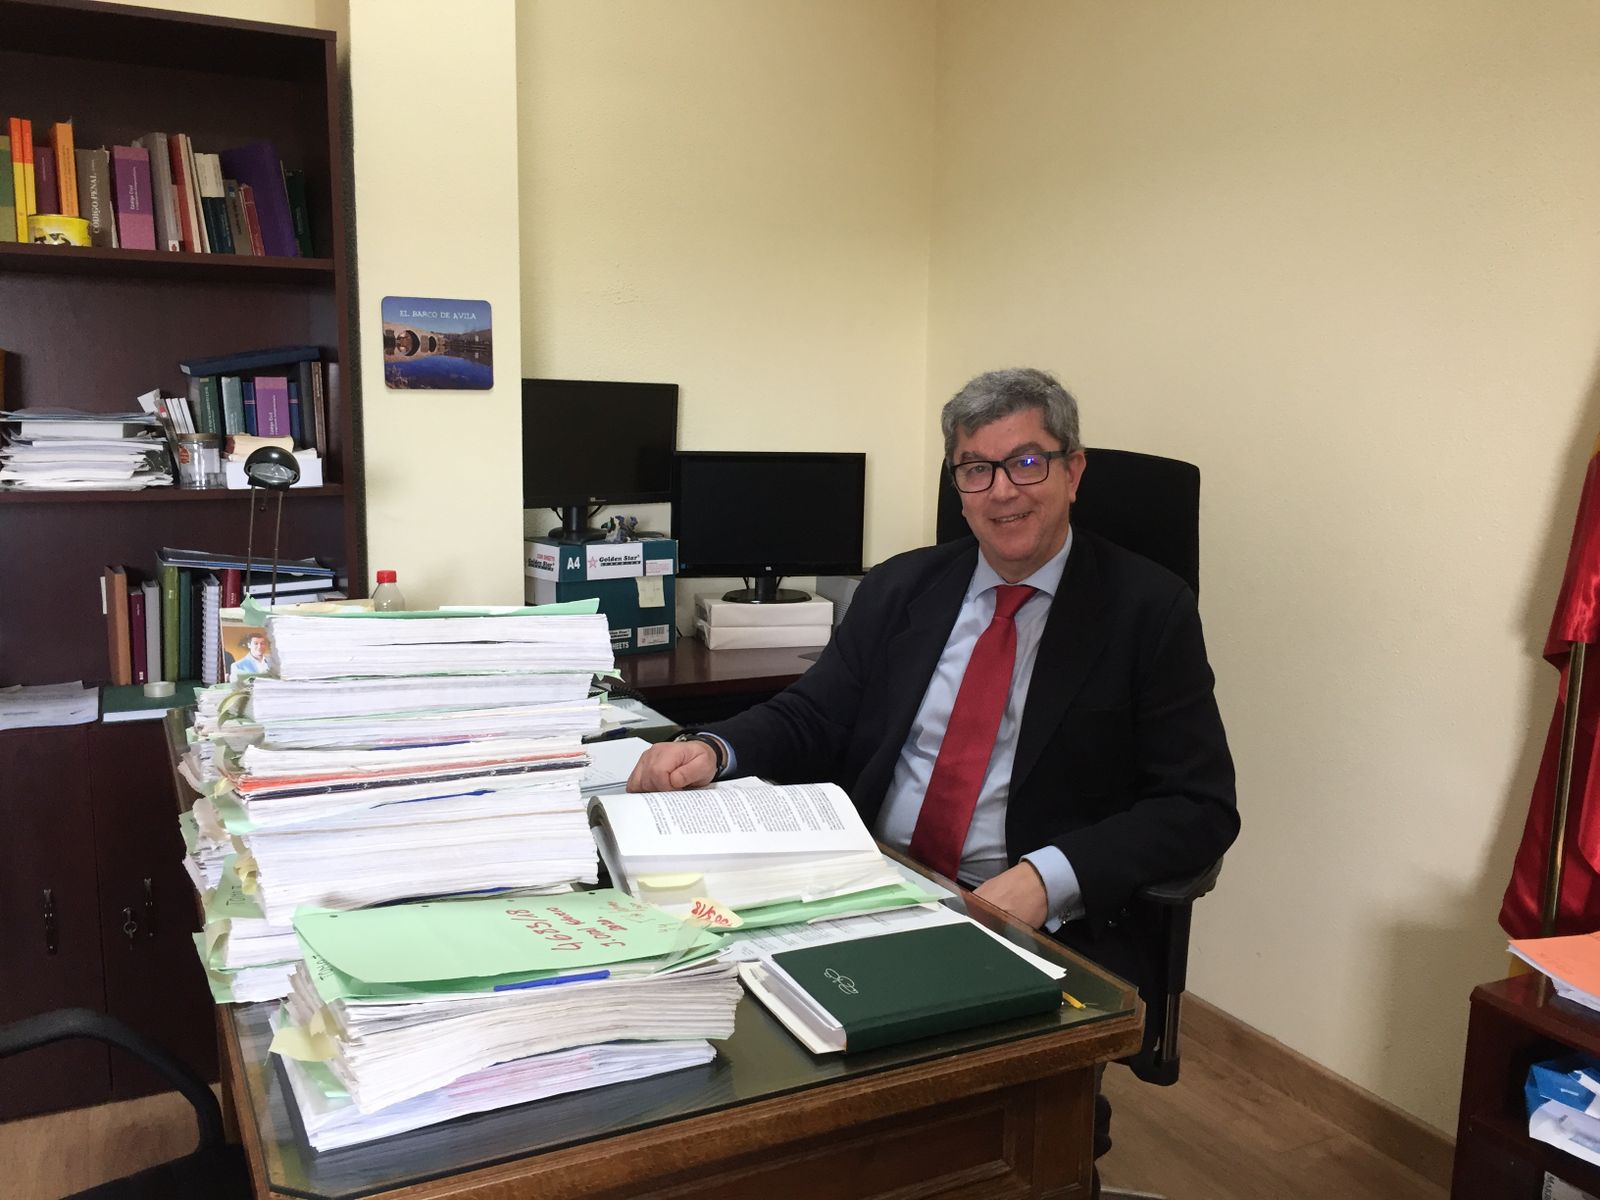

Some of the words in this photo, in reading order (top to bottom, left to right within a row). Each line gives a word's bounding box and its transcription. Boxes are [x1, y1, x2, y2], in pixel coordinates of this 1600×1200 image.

[89, 174, 97, 200] PENAL
[412, 310, 437, 319] BARCO
[440, 311, 450, 319] DE
[453, 312, 477, 320] AVILA
[567, 556, 581, 570] A4
[612, 642, 630, 650] HEETS
